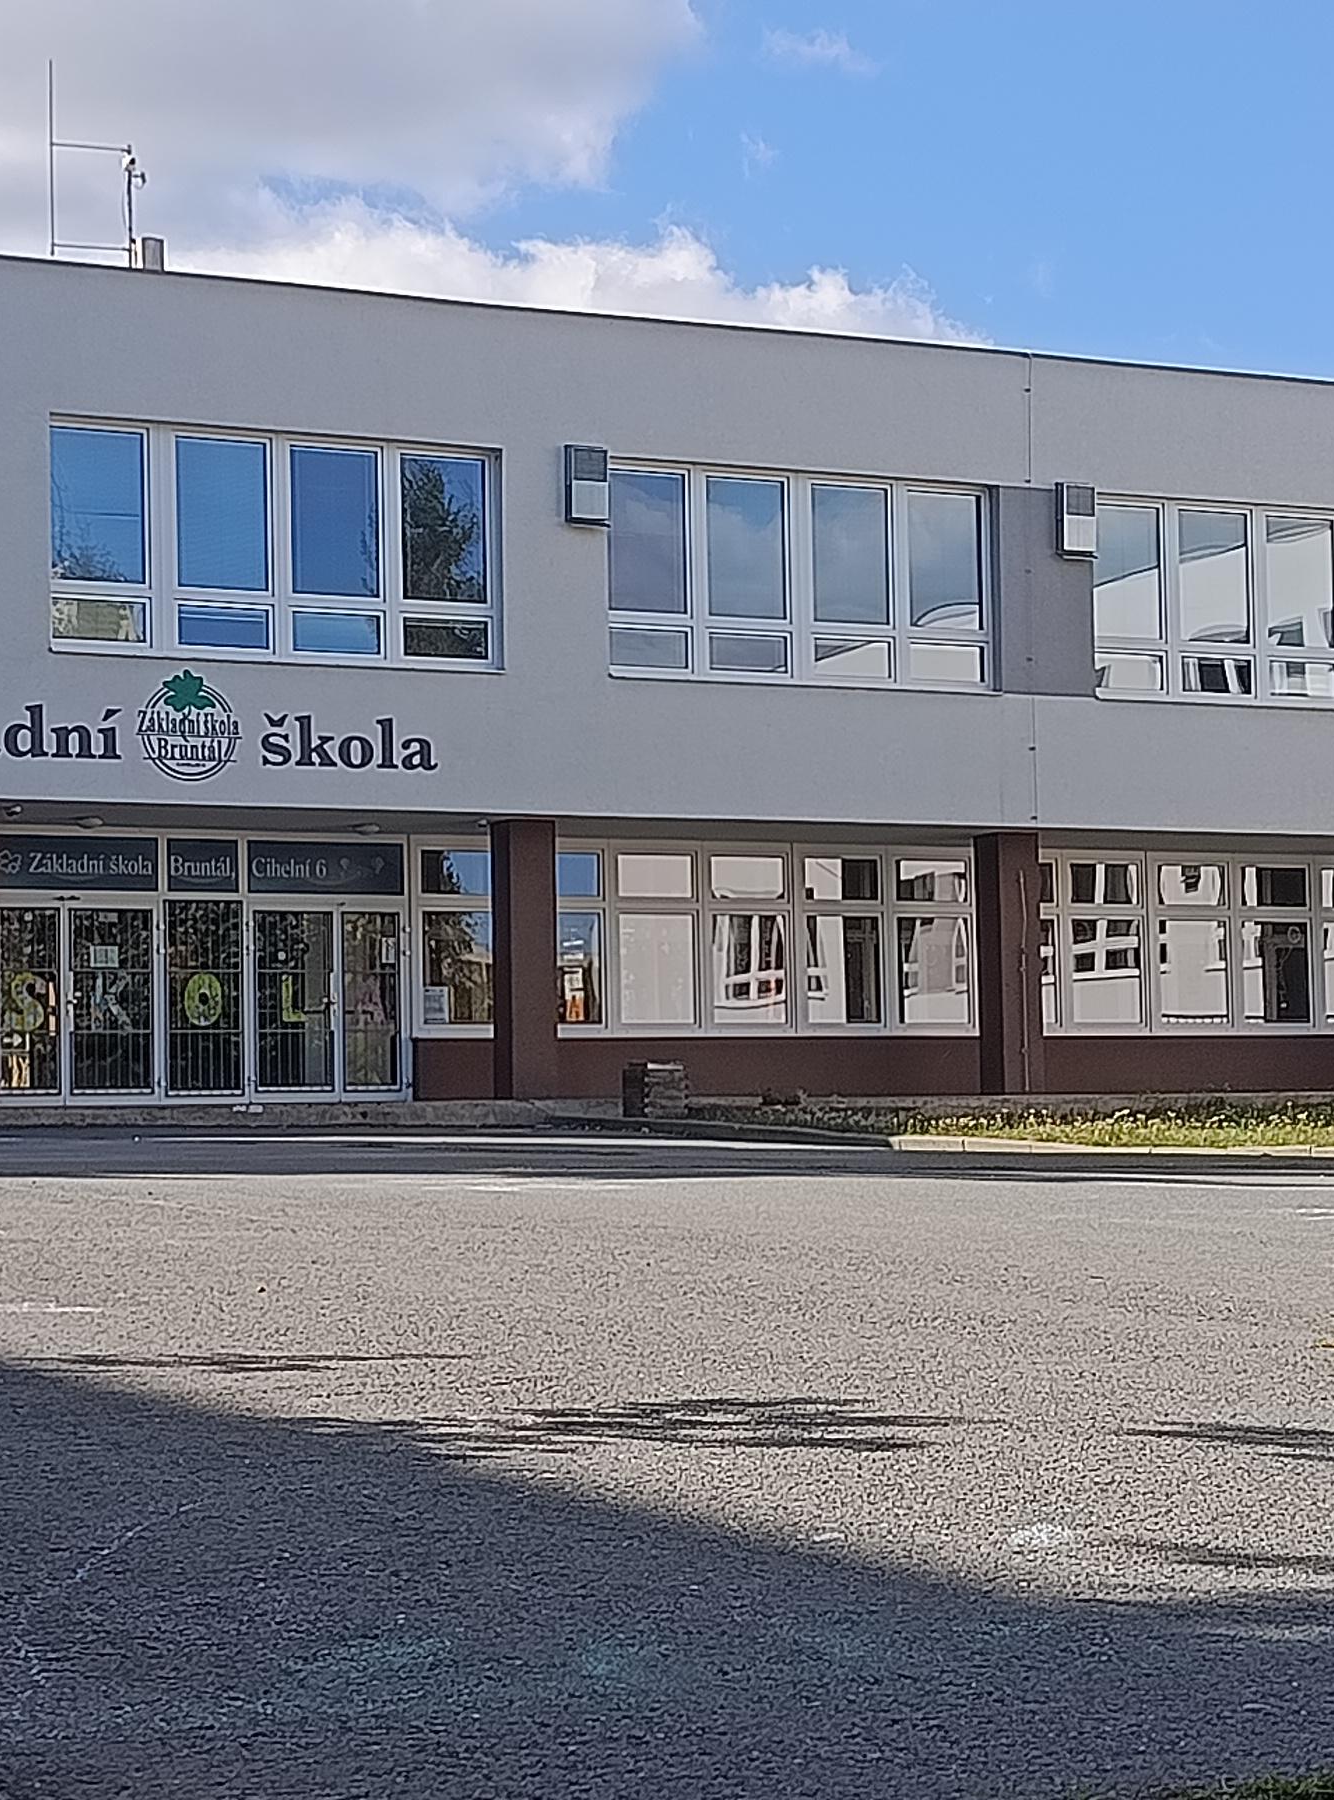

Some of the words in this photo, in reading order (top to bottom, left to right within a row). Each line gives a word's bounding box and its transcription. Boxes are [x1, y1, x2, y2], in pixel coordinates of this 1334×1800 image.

[137, 709, 201, 735] Základní
[204, 711, 240, 736] škola
[156, 737, 223, 762] Bruntál
[260, 711, 439, 771] škola
[28, 852, 105, 875] Základní
[109, 854, 154, 876] škola
[170, 854, 236, 880] Bruntál,
[251, 858, 311, 879] Cihelní
[315, 859, 327, 878] 6
